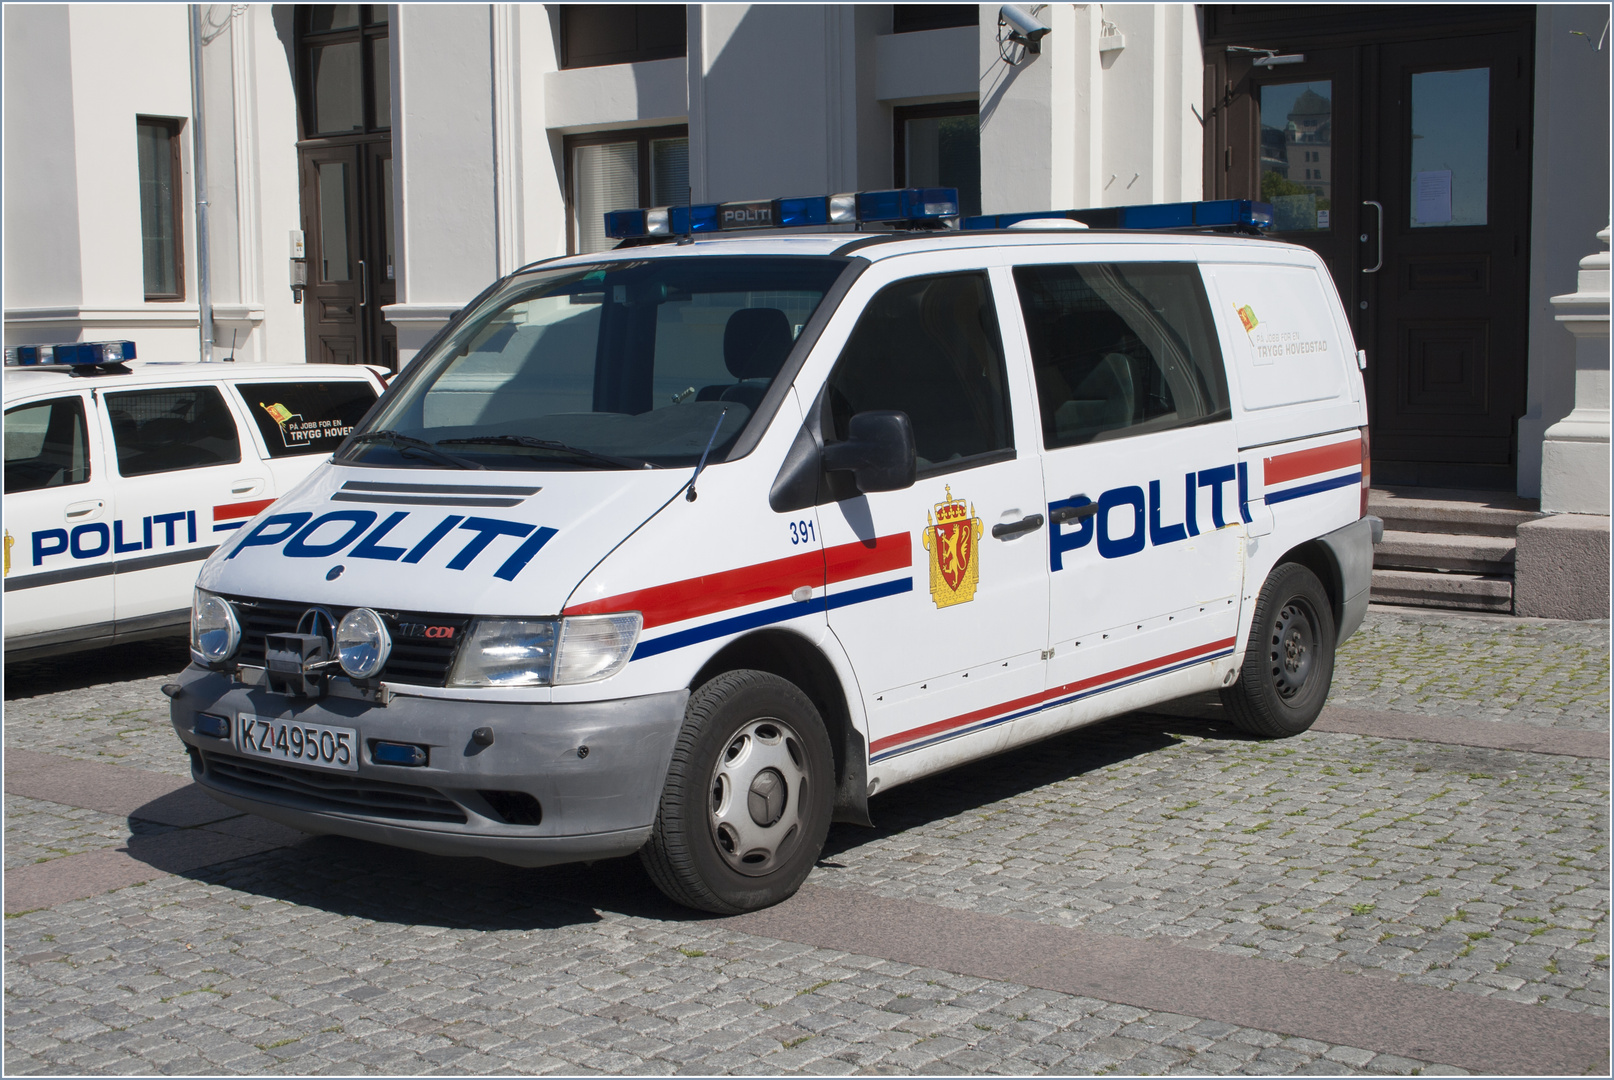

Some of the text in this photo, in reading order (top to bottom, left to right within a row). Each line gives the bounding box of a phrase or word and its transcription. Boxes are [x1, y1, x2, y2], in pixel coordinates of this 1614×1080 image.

[724, 209, 772, 222] POLITI
[1281, 332, 1290, 342] FOR
[1292, 332, 1300, 340] EN
[1257, 340, 1328, 358] TRYGG HOVEDSTAD
[289, 422, 298, 430] PÅ
[300, 422, 318, 430] JOBB
[290, 430, 322, 440] TRYGG
[1048, 461, 1253, 572] POLITI
[31, 510, 197, 566] POLITI
[789, 519, 816, 545] 391
[223, 510, 560, 582] POLITI
